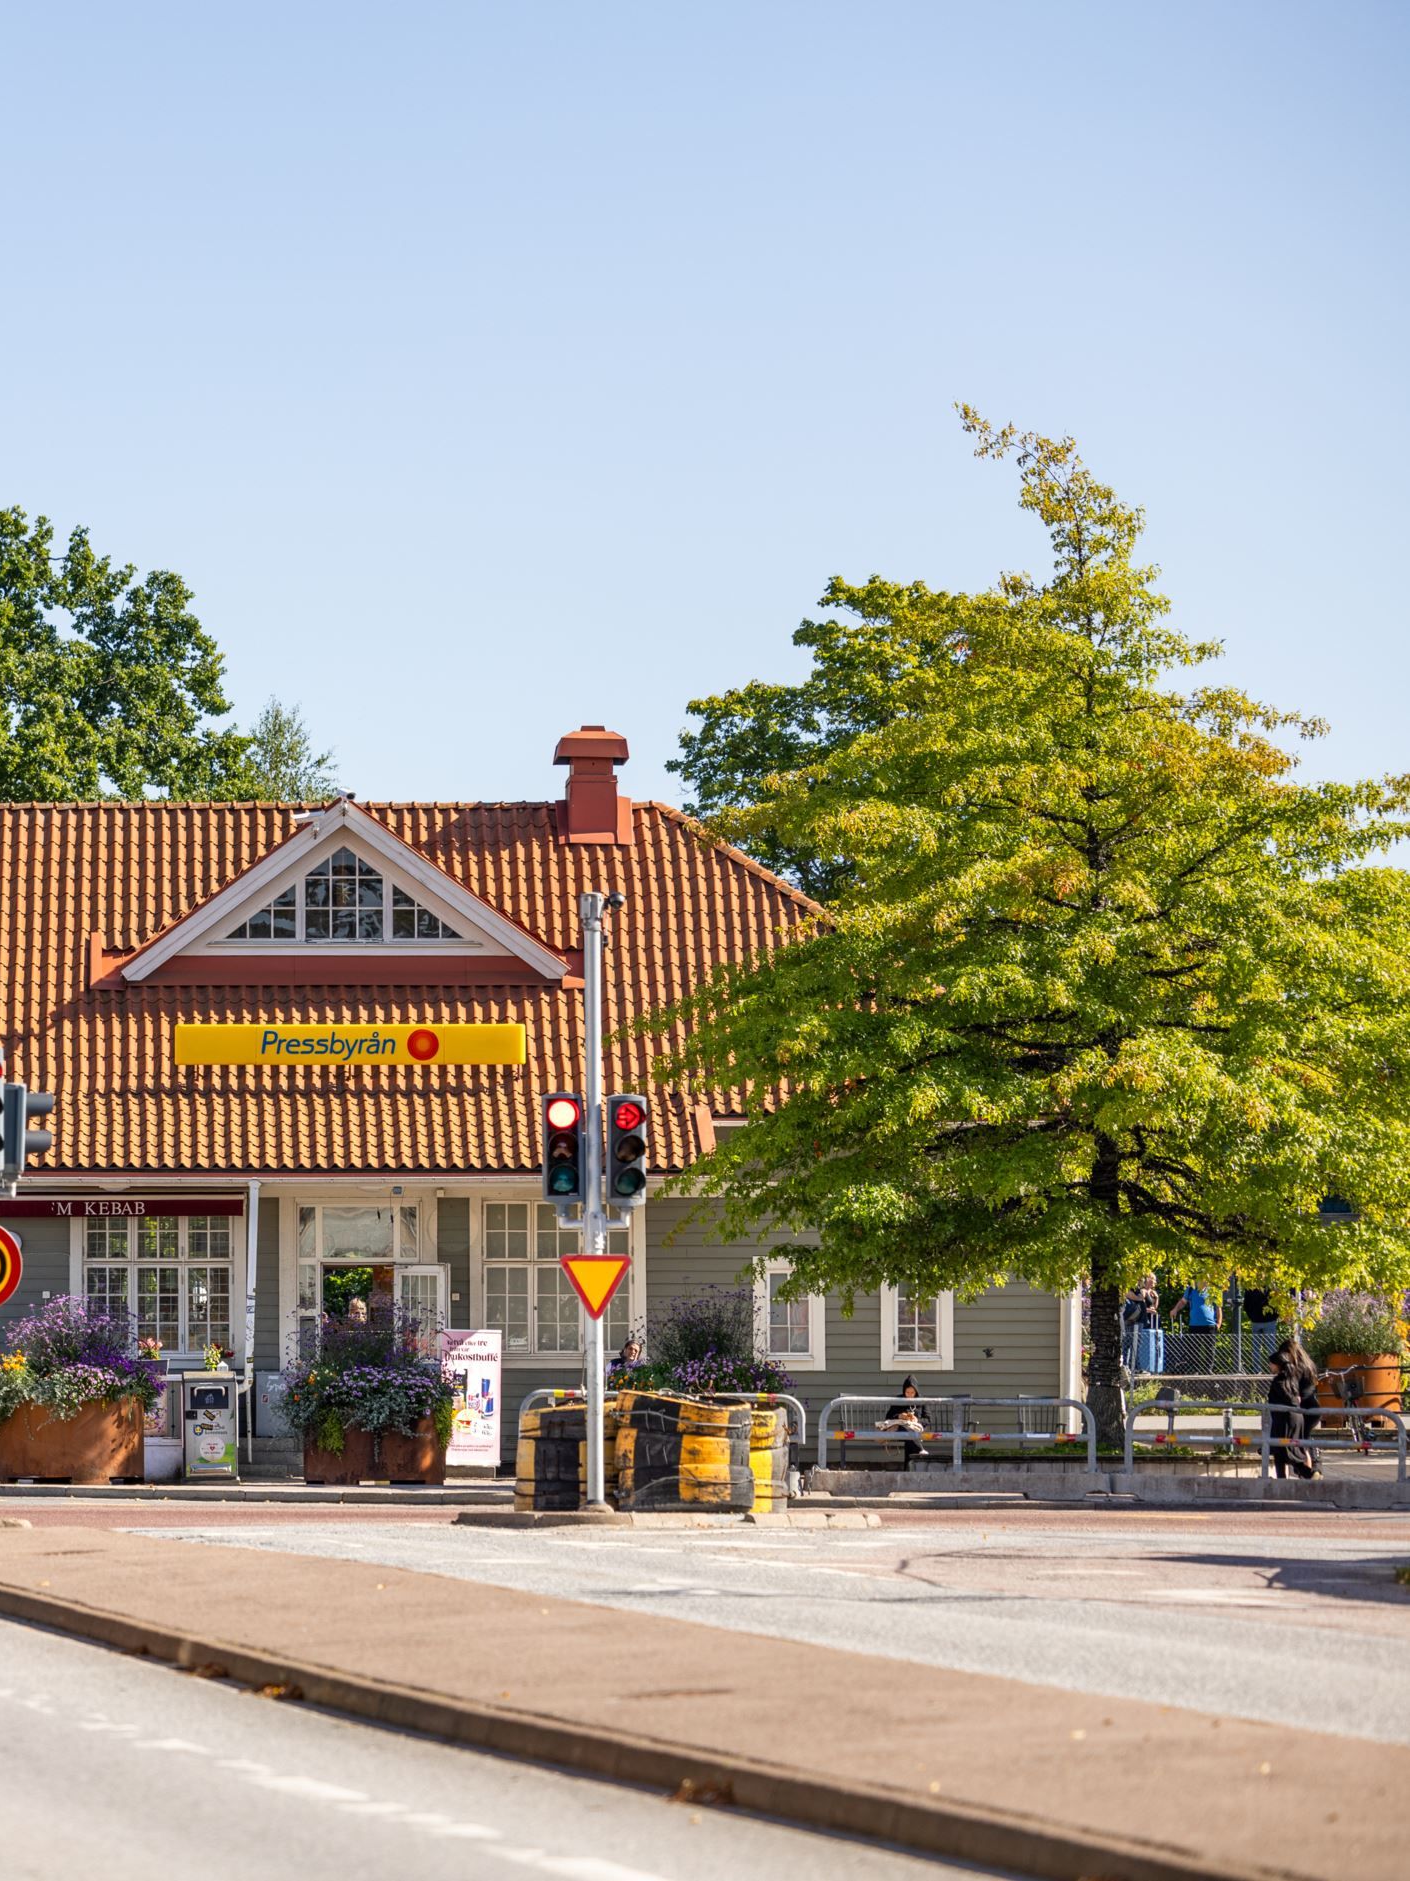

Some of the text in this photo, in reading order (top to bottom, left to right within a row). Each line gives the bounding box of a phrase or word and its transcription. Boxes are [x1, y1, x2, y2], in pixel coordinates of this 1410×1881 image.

[261, 1031, 396, 1061] Pressbyrån
[51, 1201, 146, 1216] M KEBAB
